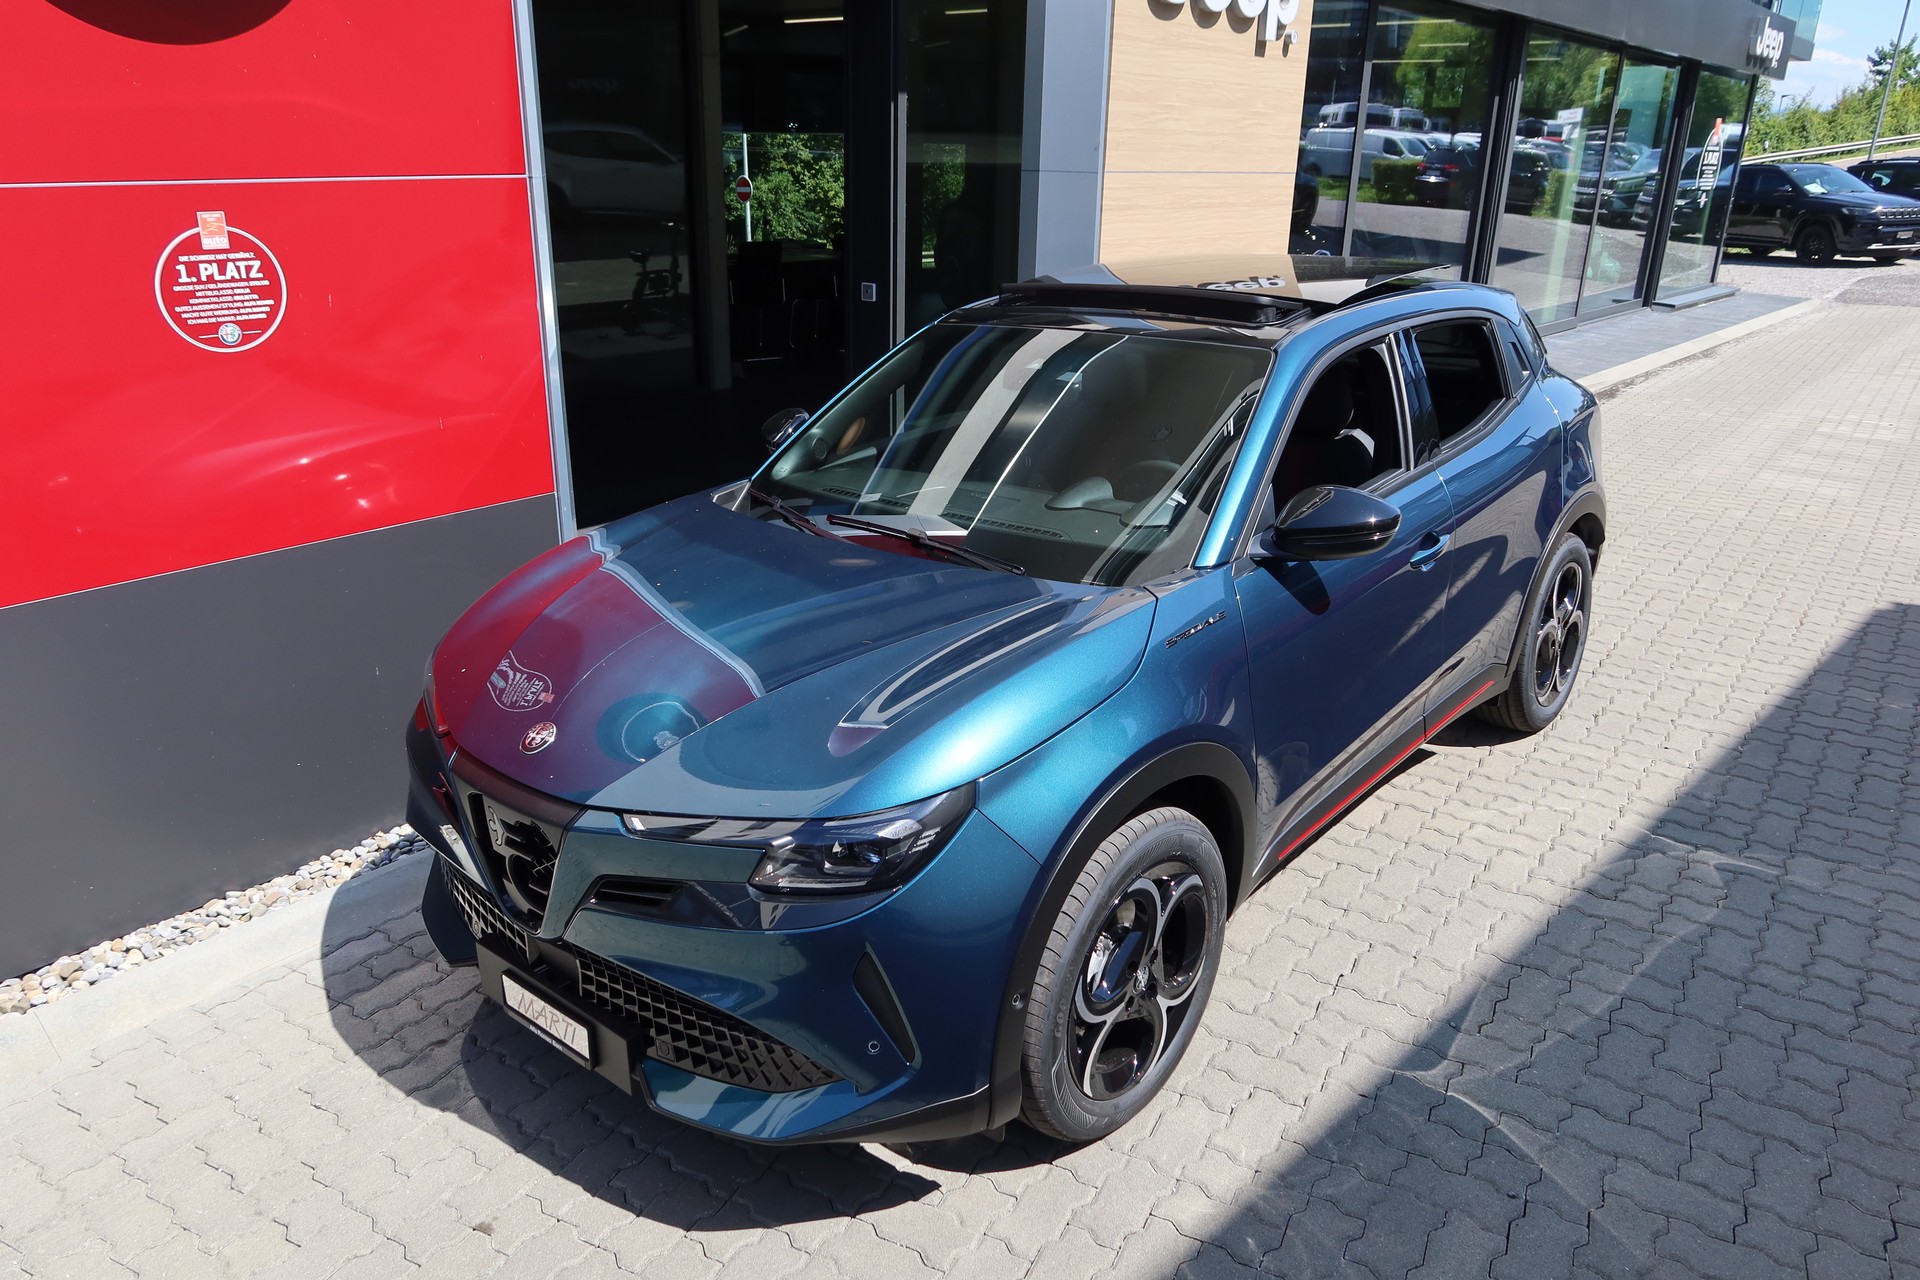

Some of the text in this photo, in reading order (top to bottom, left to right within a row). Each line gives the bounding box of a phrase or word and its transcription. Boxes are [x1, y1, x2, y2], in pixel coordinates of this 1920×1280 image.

[1756, 16, 1784, 66] Jeep
[175, 260, 264, 283] 1. PLATZ
[518, 992, 577, 1045] MARTI
